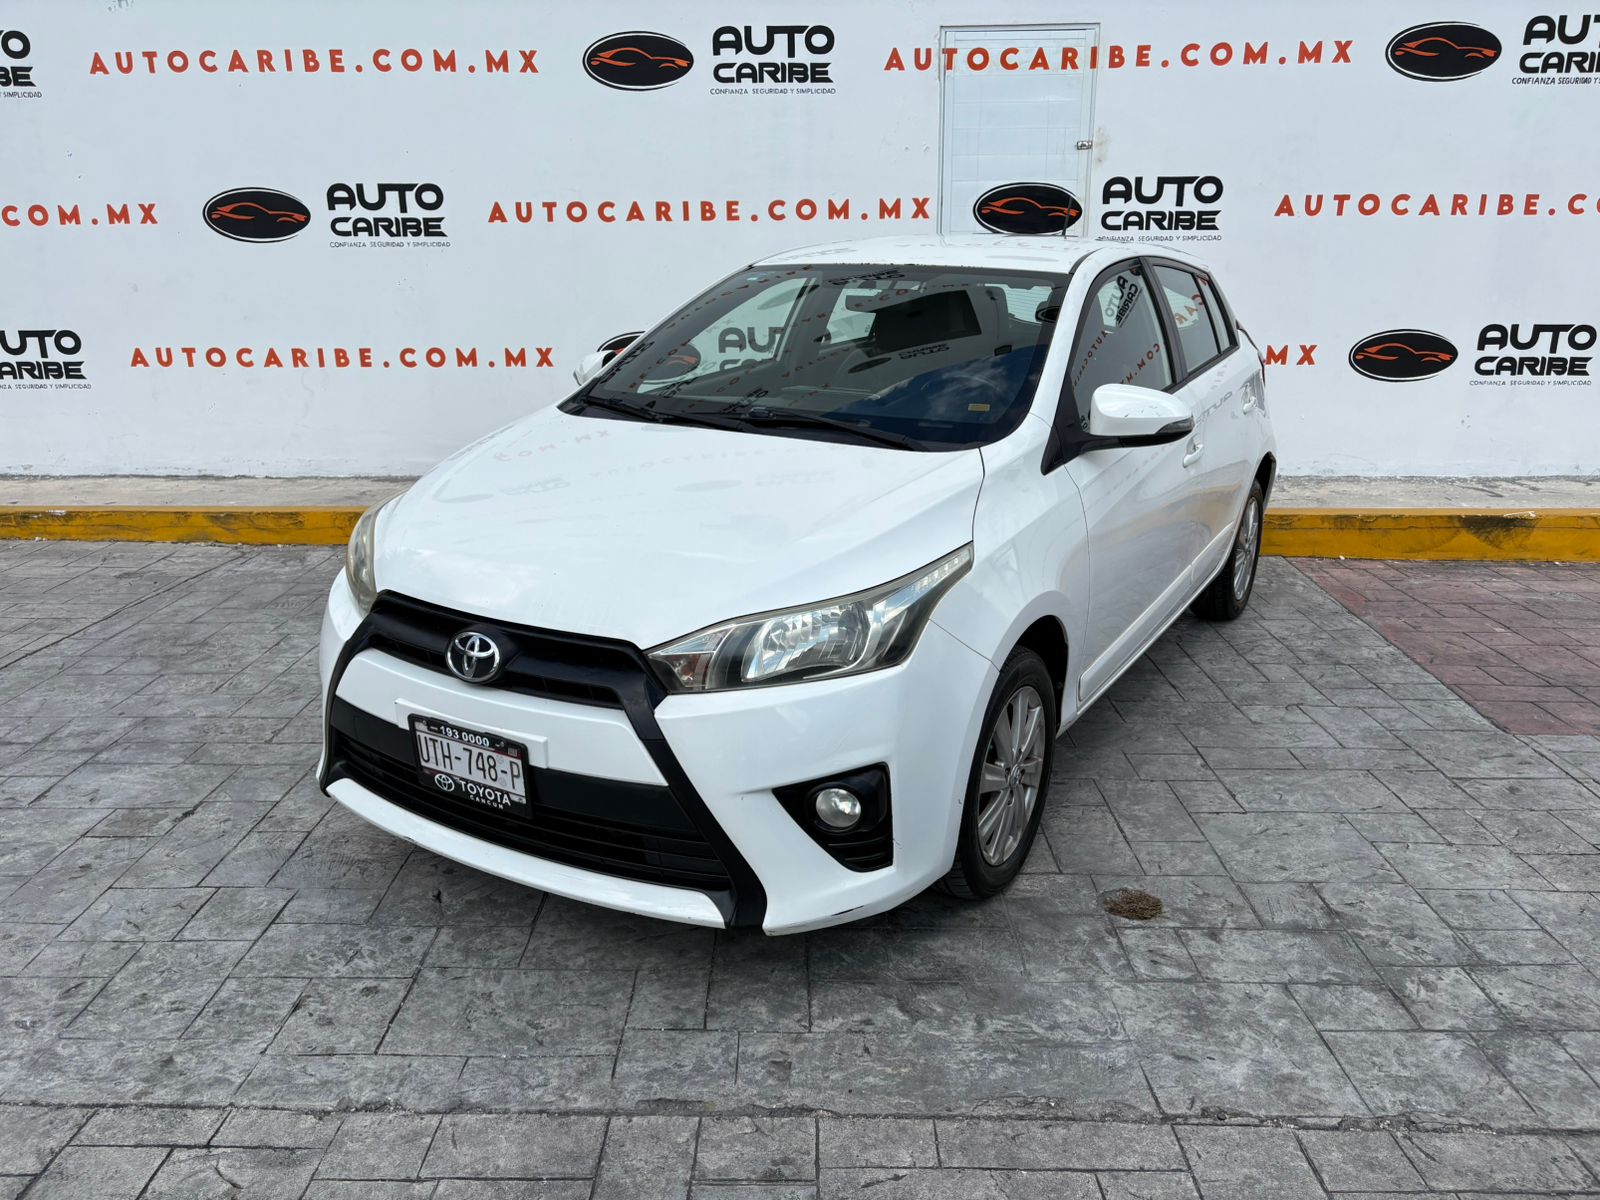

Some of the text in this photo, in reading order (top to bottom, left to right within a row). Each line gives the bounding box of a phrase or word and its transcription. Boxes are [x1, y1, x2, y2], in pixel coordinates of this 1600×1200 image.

[0, 30, 31, 59] O
[712, 25, 835, 58] AUTO
[90, 48, 539, 76] AUTOCARIBE.COM.MX
[884, 40, 1353, 72] AUTOCARIBE.COM.MX
[1519, 51, 1600, 73] CARI
[713, 62, 834, 83] CARIBE
[1511, 77, 1556, 85] CONFIANZA
[3, 91, 42, 99] SIMPLICIDAD
[326, 183, 444, 213] AUTO
[1102, 176, 1224, 207] AUTO
[488, 197, 929, 225] AUTOCARIBE.COM.MX
[1275, 193, 1600, 218] AUTOCARIBE.C
[330, 216, 448, 237] CARIBE
[1100, 210, 1221, 231] CARIBE
[1476, 324, 1598, 354] AUTO
[130, 347, 553, 369] AUTOCARIBE.COM.MX
[1474, 356, 1593, 376] CARIBE
[440, 726, 490, 747] 193 0000
[417, 734, 521, 790] UTH-748-P
[460, 780, 511, 806] TOYOTA
